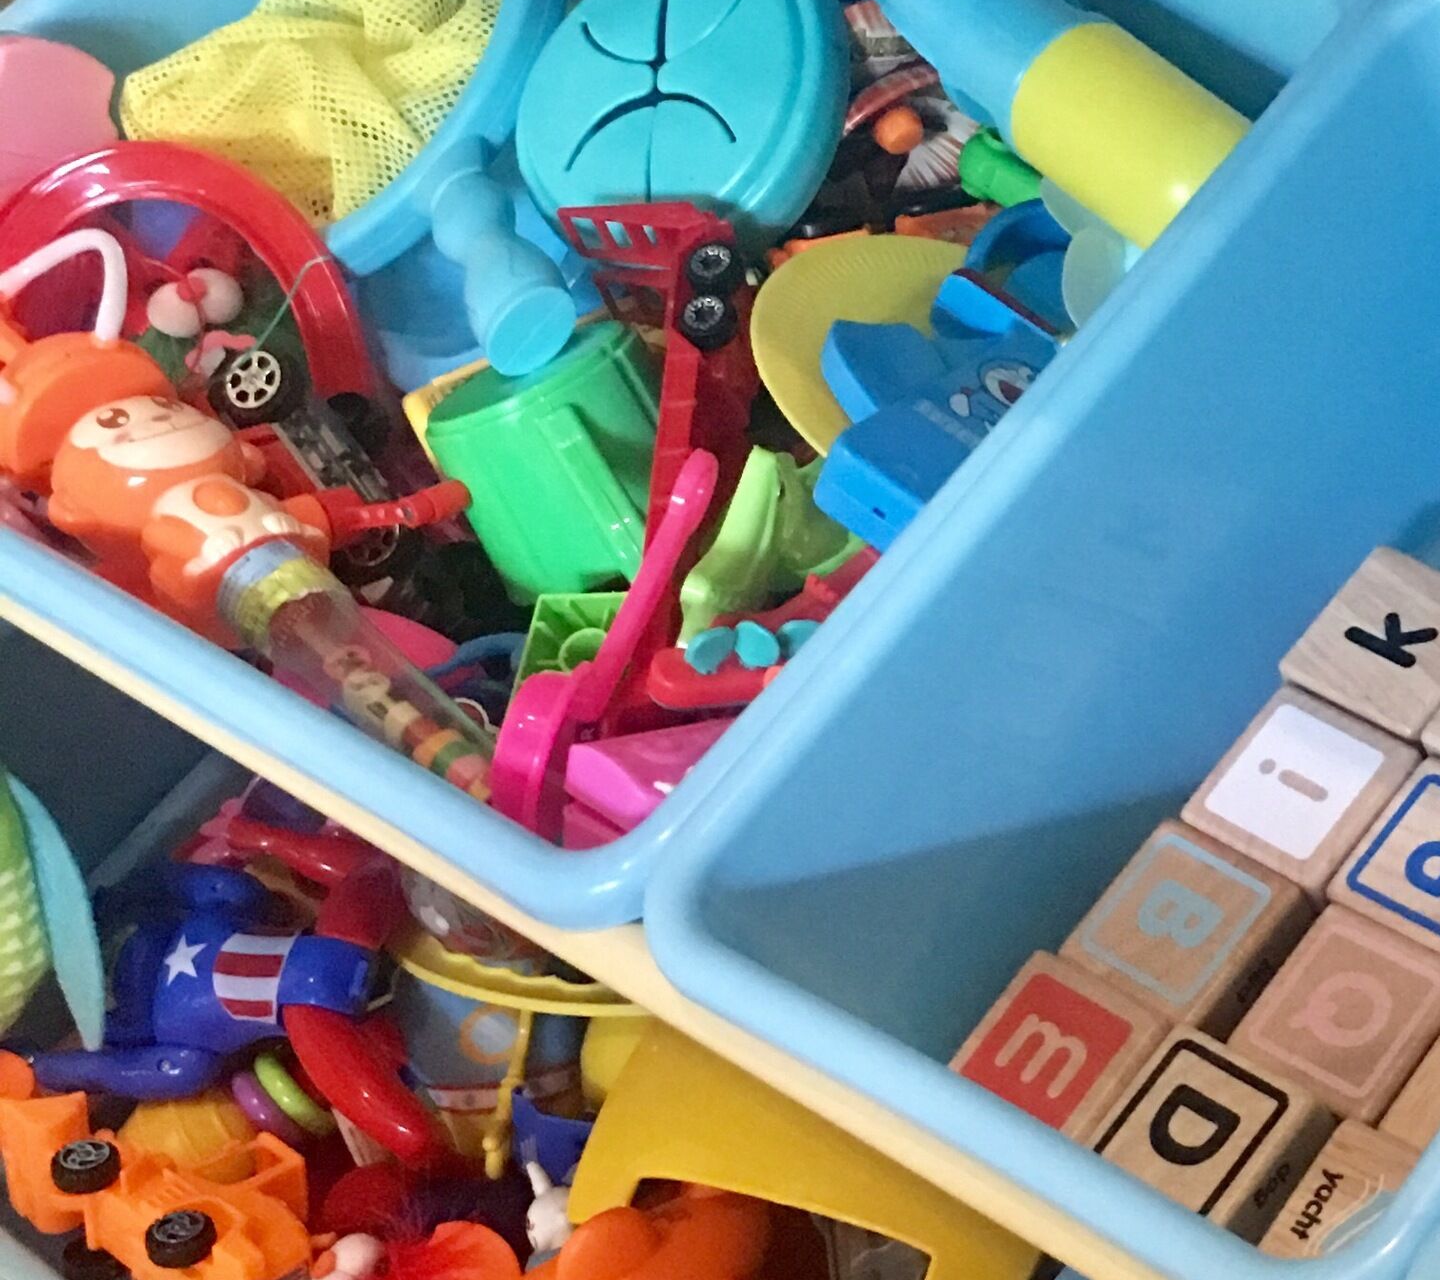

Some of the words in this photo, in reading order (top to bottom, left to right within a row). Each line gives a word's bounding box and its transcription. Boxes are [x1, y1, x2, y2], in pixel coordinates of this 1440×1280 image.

[1133, 882, 1223, 950] B
[1289, 968, 1395, 1048] Q
[1147, 1082, 1242, 1168] D
[1288, 1166, 1346, 1241] yacht
